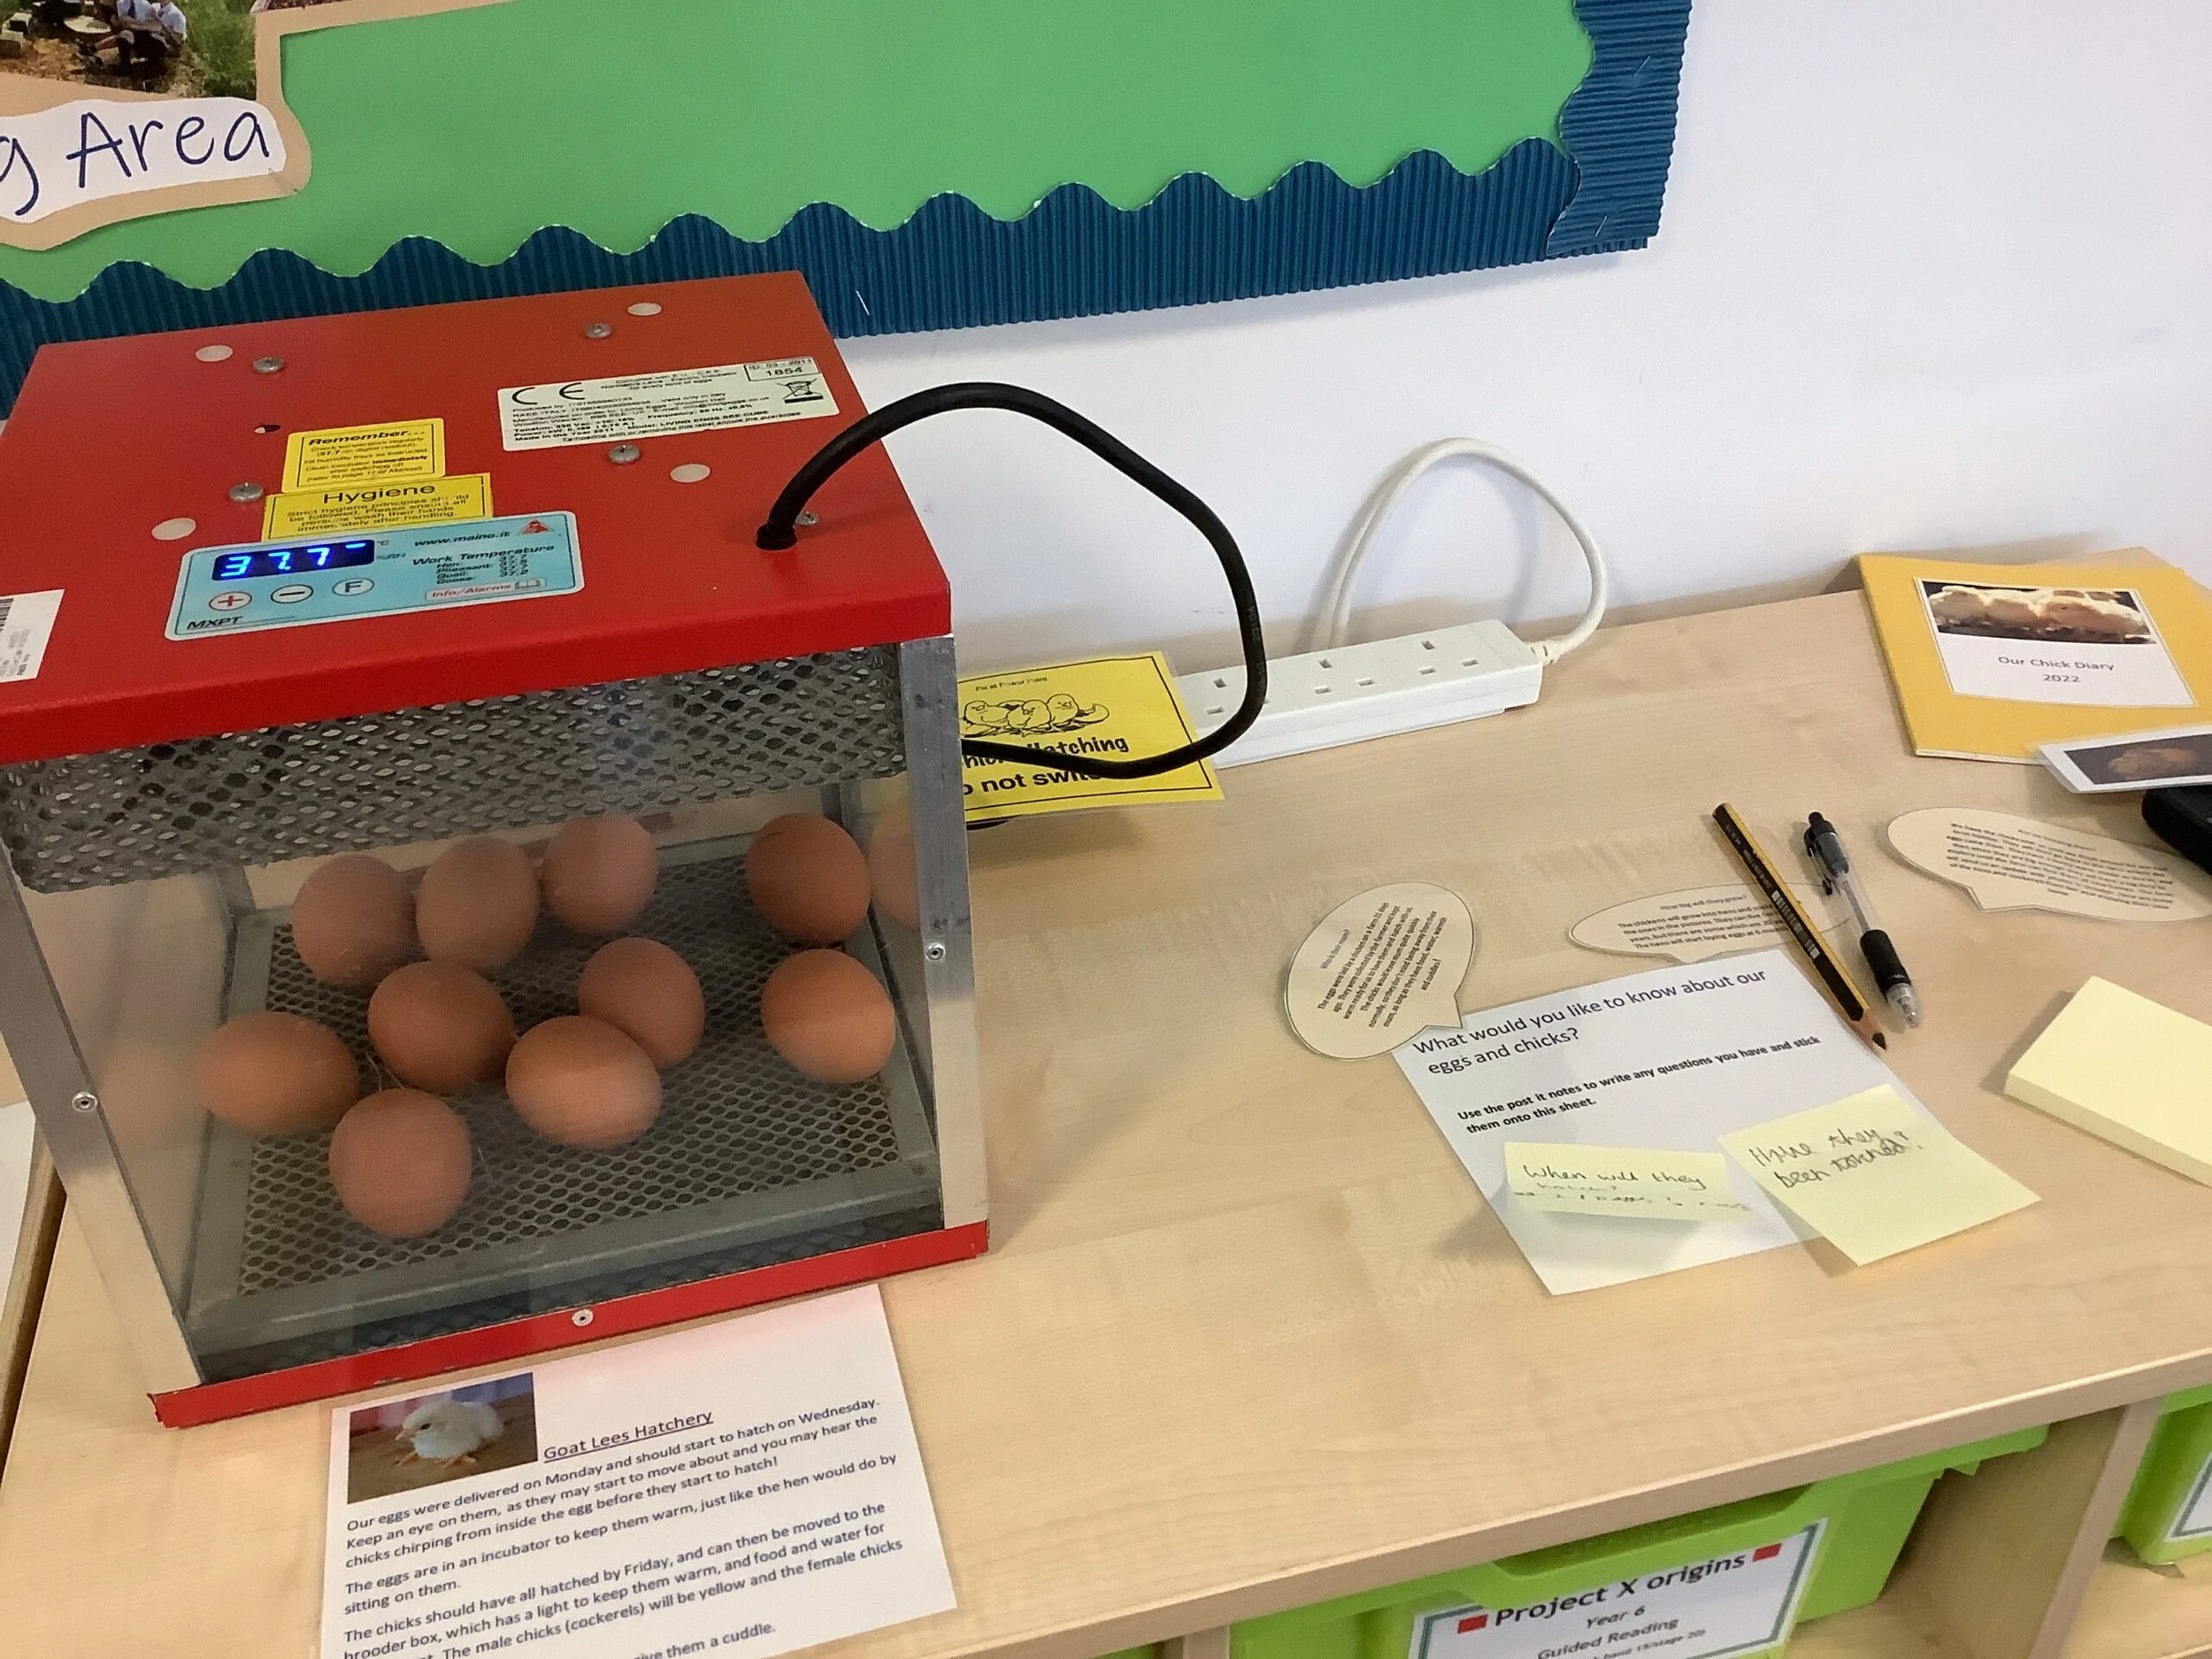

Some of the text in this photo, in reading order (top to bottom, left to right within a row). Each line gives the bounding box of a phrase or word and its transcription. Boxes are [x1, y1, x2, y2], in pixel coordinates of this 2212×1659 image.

[65, 111, 270, 188] Area
[766, 367, 803, 376] 1854
[308, 430, 425, 446] Remember...
[373, 455, 427, 465] immediately
[323, 485, 435, 504] Hygiene
[321, 504, 368, 515] hygiene
[403, 512, 453, 521] handling
[414, 532, 511, 546] www.maino.it
[412, 545, 555, 565] Work Temperature
[343, 580, 362, 595] F
[432, 584, 511, 598] Info/Alarms
[186, 616, 243, 630] MXPT
[2031, 659, 2070, 668] Chick
[2075, 662, 2114, 671] Diary
[2043, 674, 2080, 683] 2022
[981, 773, 1030, 792] not
[1413, 970, 1766, 1054] What would you like to know about our
[1429, 1027, 1578, 1074] eggs and chicks?
[1457, 1036, 1820, 1120] Use the post it notes to write any questions you have and stick
[1466, 1096, 1596, 1133] them onto this sheet.
[1829, 1128, 1882, 1148] they
[1524, 1164, 1707, 1190] When will they
[1774, 1169, 1831, 1188] been
[543, 1411, 713, 1463] Goat Lees Hatchery
[347, 1399, 879, 1532] Our eggs were delivered on Monday and should start to hatch on Wednesday.
[346, 1416, 878, 1550] Keep an eye on them, as they may start to move about and you may hear the
[345, 1455, 778, 1569] chicks chirping from inside the egg before they start to hatch!
[344, 1454, 896, 1595] The eggs are in an incubator to keep them warm, just like the hen would do by
[1494, 1554, 1746, 1626] Project X origins
[1586, 1605, 1646, 1629] Year 6
[1538, 1618, 1679, 1659] Guided Reading
